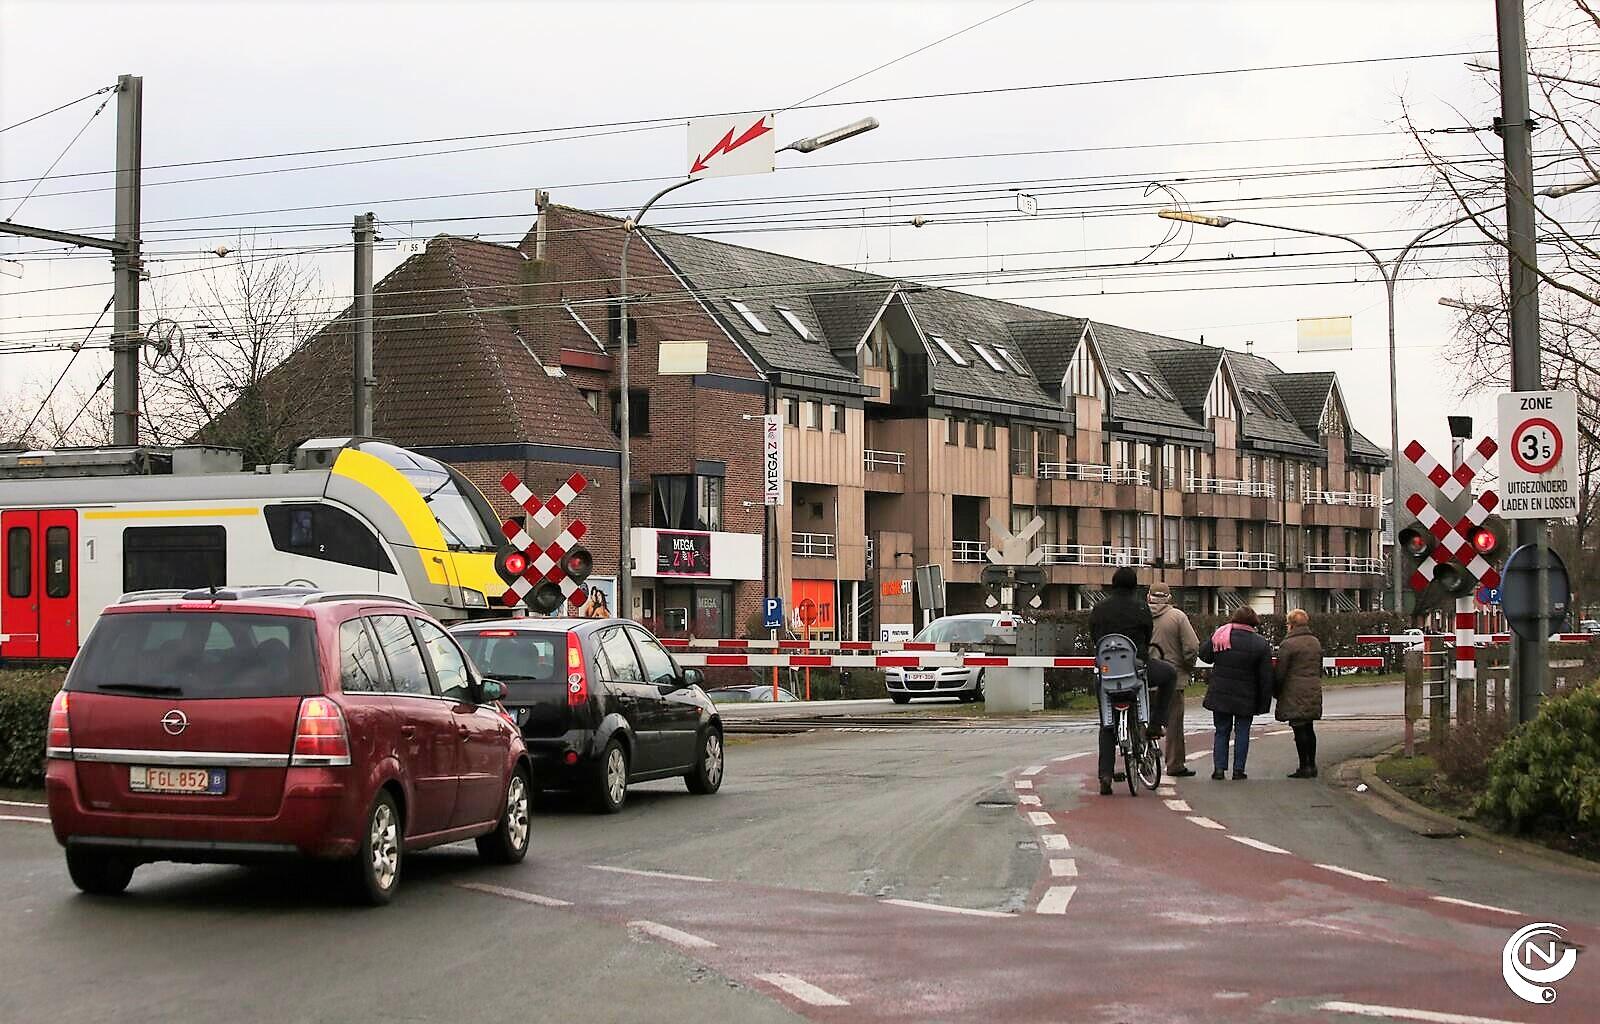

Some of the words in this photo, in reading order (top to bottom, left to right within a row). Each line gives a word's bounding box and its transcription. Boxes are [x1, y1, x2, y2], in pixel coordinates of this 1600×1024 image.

[1520, 397, 1553, 410] ZONE
[1522, 434, 1539, 461] 3
[1542, 445, 1551, 459] 5
[1507, 480, 1568, 494] UITGEZONDERD
[1501, 498, 1529, 511] LADEN
[1531, 497, 1542, 510] EN
[1544, 496, 1576, 510] LOSSEN
[85, 539, 95, 560] 1
[319, 544, 325, 552] 2
[672, 538, 695, 551] MEGA
[1490, 589, 1498, 598] P
[767, 599, 778, 616] P
[213, 776, 221, 785] B
